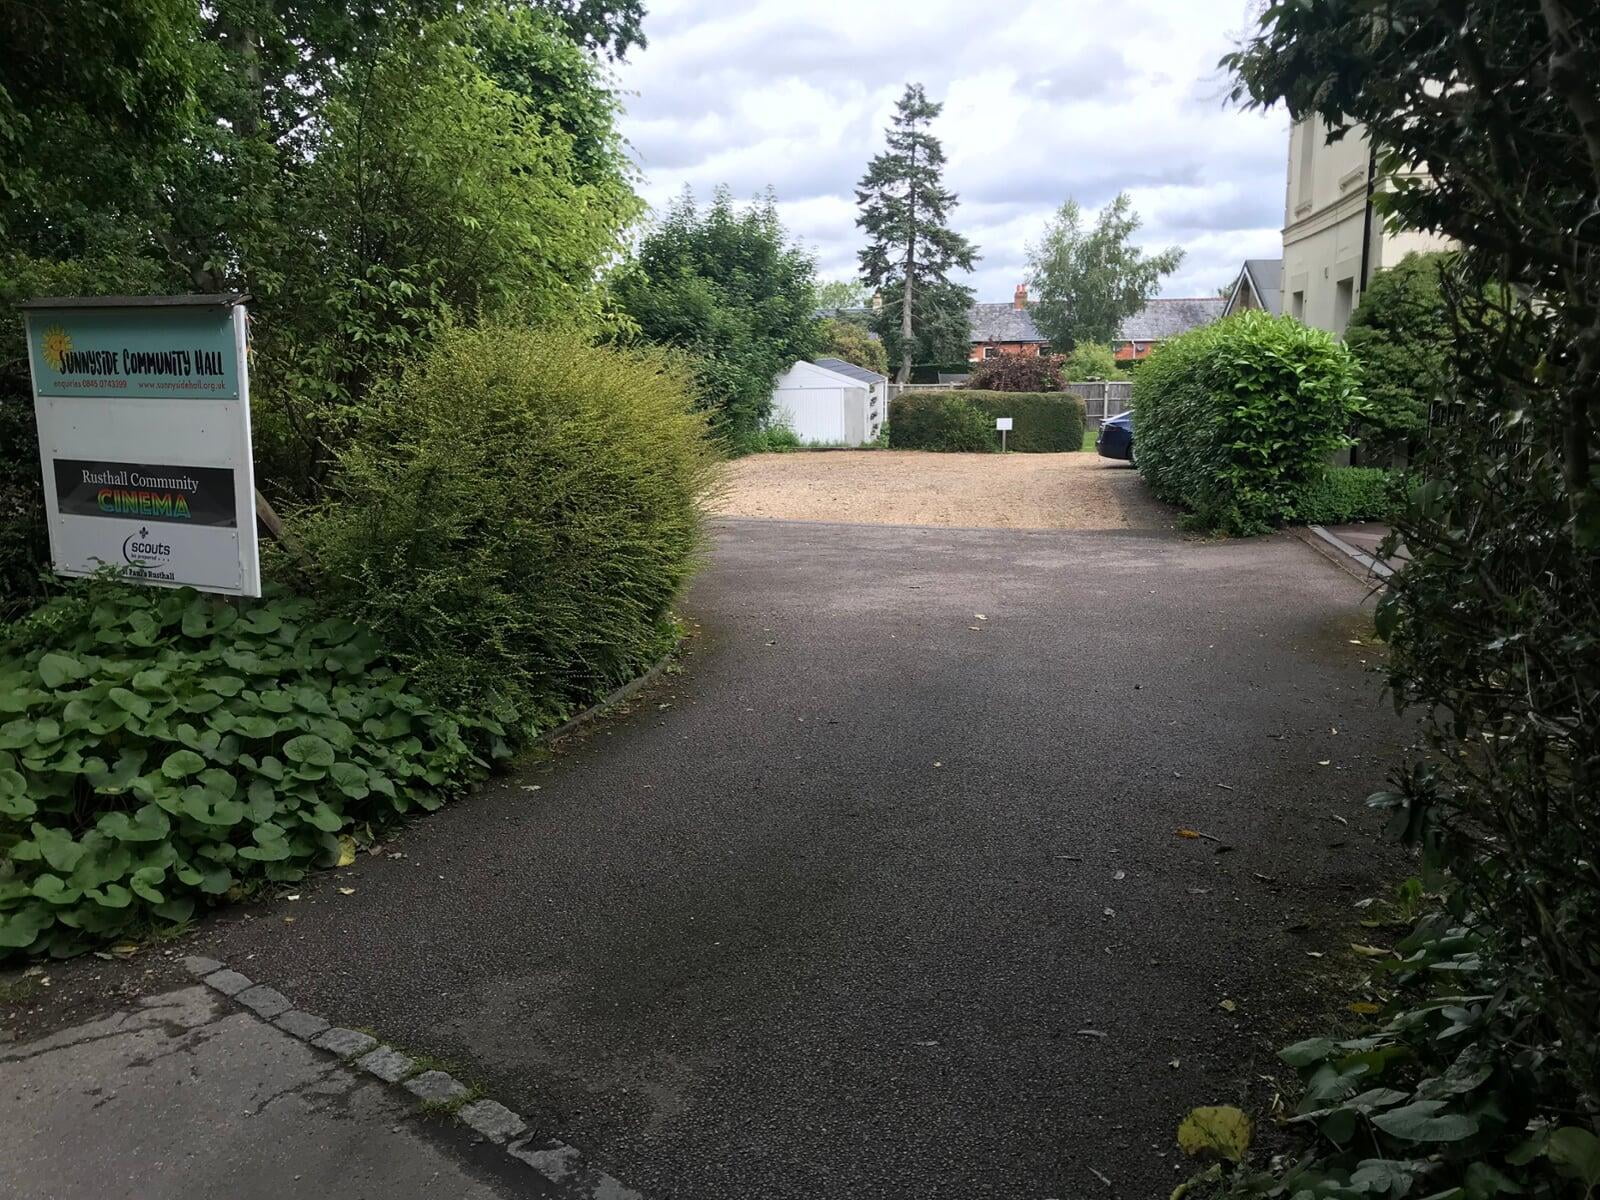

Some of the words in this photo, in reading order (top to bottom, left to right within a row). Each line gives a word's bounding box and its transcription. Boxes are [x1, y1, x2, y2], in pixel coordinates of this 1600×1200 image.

[123, 348, 190, 376] COMMUNITY
[195, 350, 224, 376] HALL
[82, 470, 128, 485] Rusthall
[131, 473, 199, 493] Community
[98, 489, 191, 518] CINEMA
[148, 570, 175, 580] Rusthall
